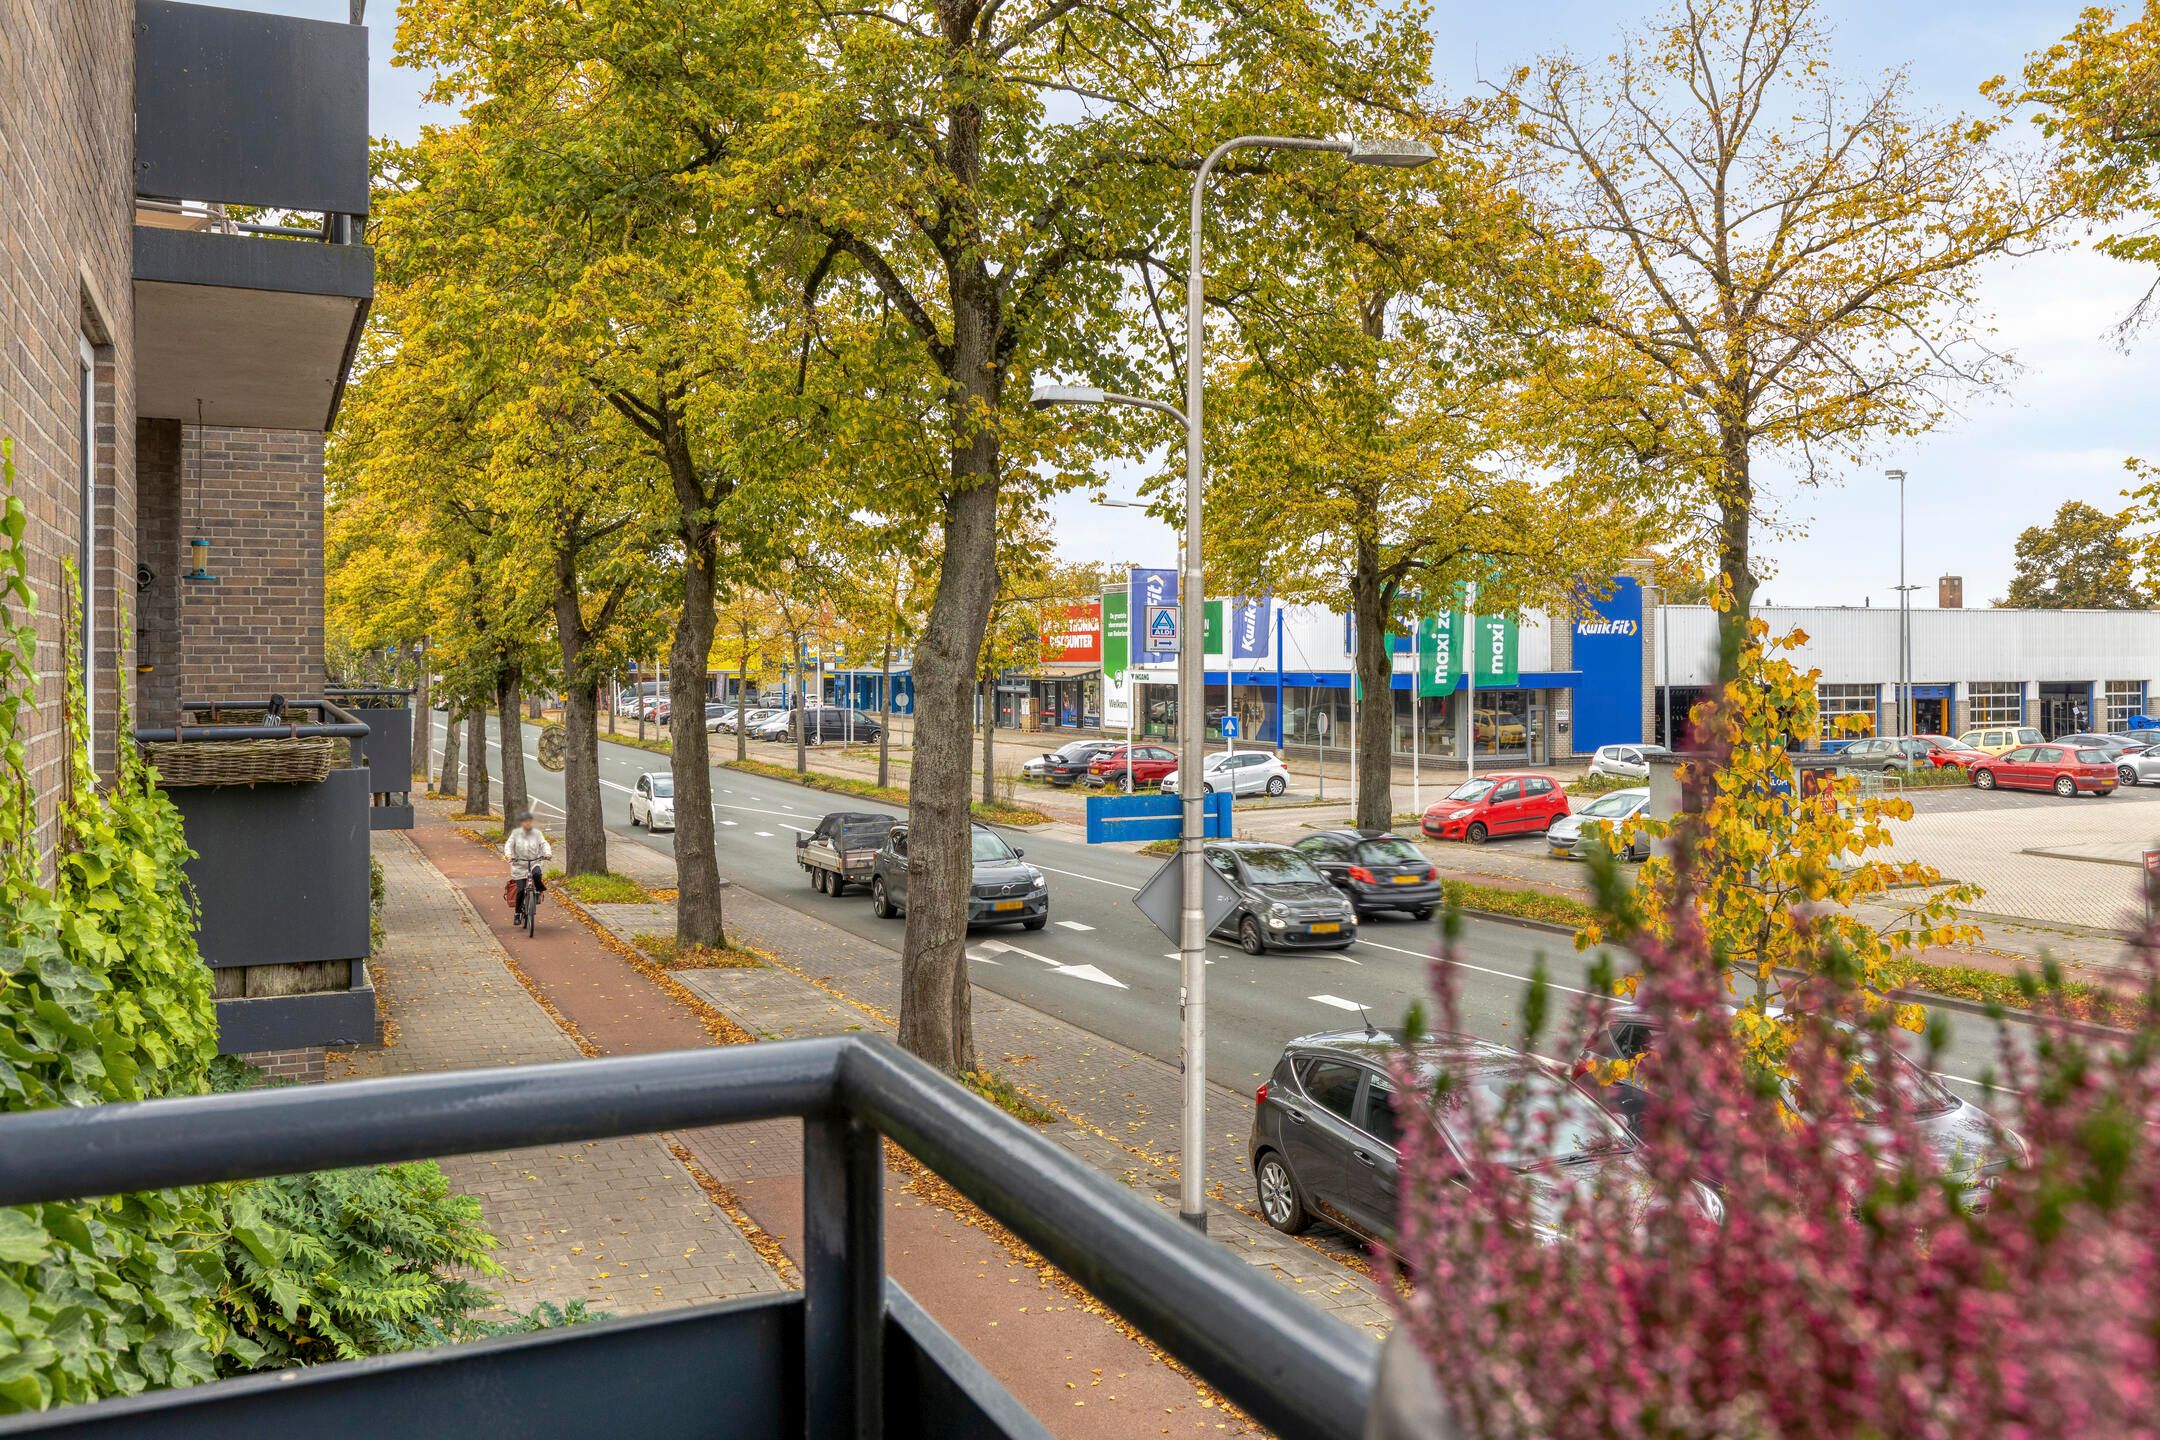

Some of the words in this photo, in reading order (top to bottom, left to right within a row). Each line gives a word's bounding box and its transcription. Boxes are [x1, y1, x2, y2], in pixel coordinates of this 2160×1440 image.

[1438, 606, 1450, 629] zo
[1431, 633, 1450, 684] maxi
[1486, 623, 1505, 675] maxi
